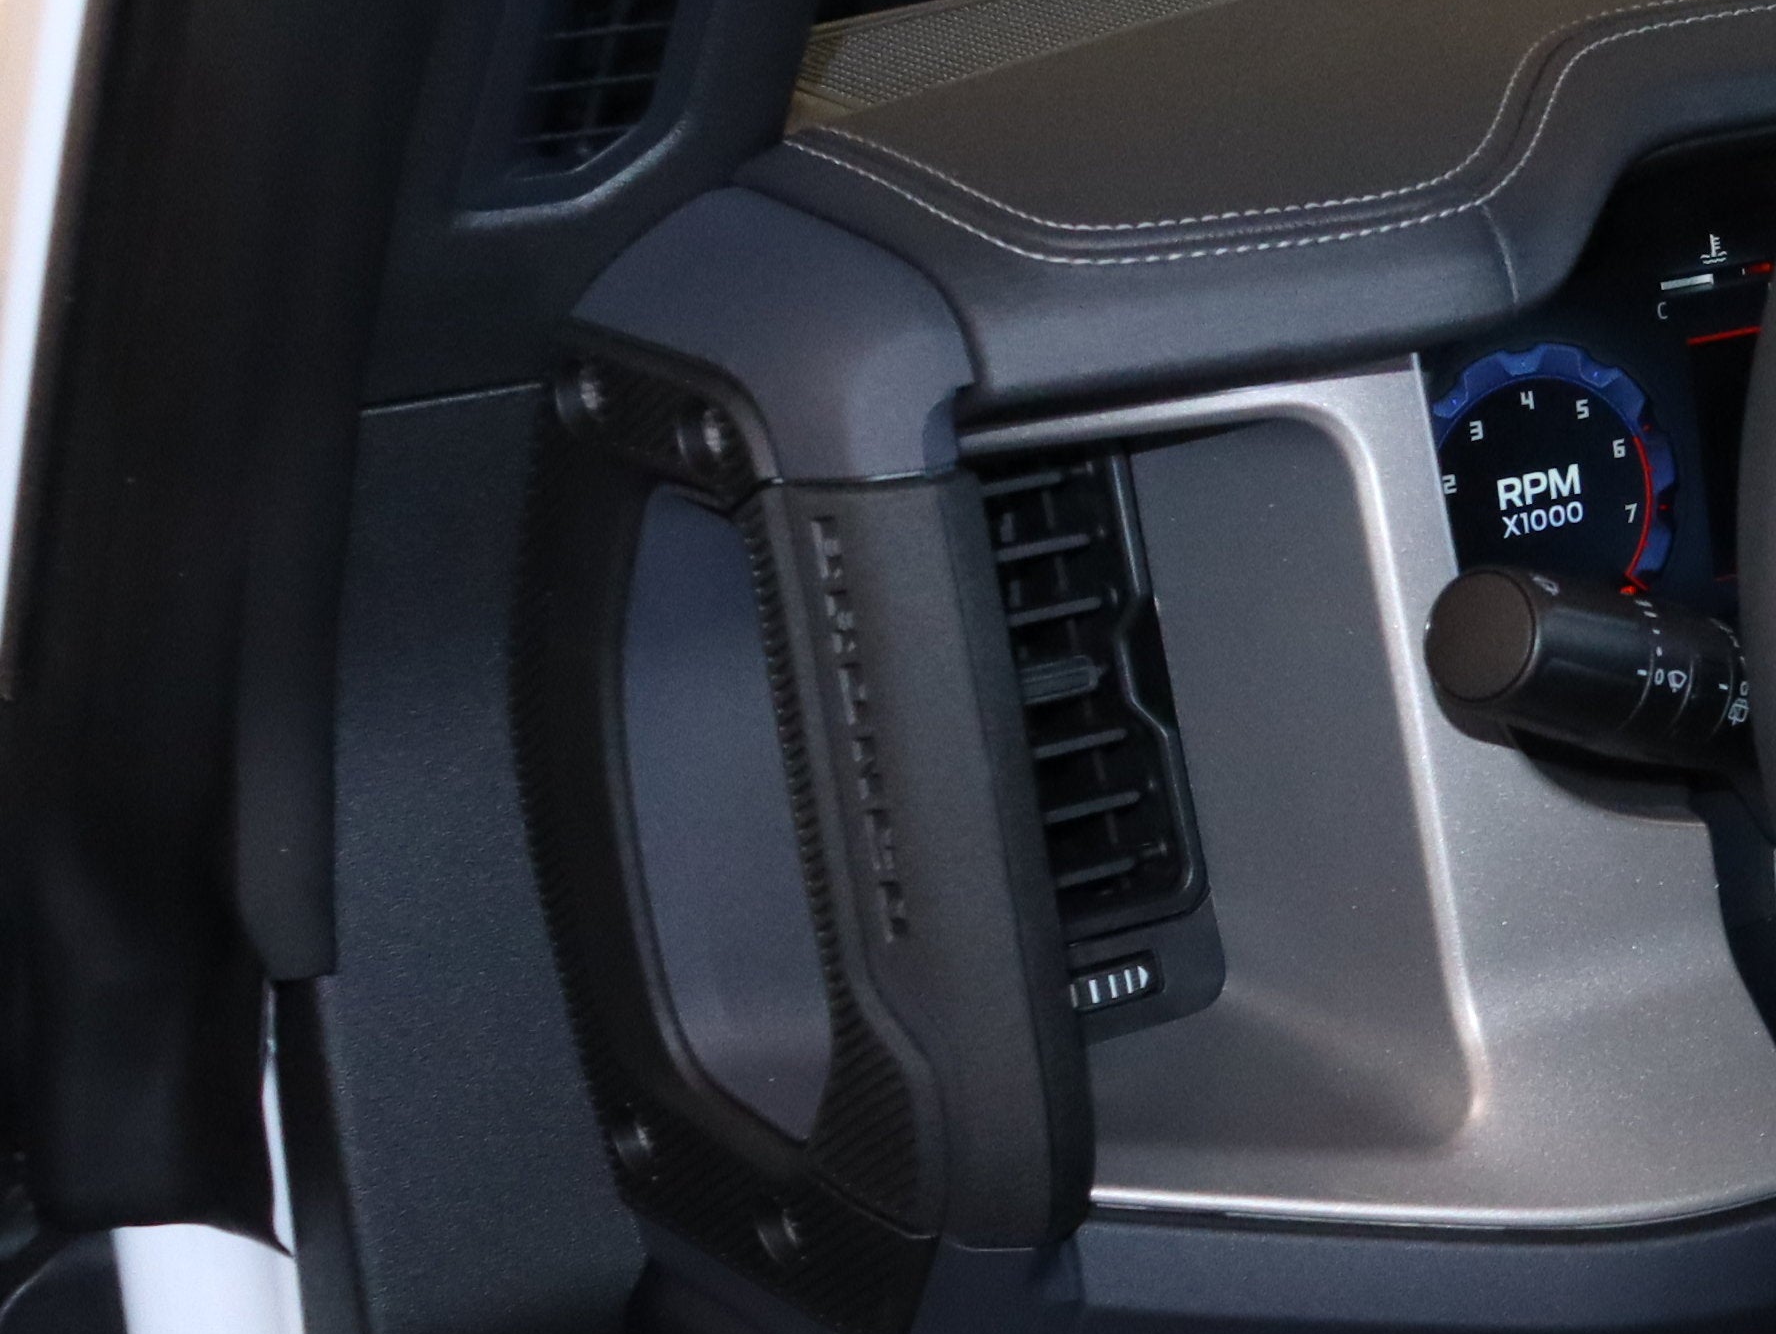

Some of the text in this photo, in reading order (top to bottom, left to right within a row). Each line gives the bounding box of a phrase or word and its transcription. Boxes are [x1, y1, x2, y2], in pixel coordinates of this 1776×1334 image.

[1657, 300, 1669, 320] C
[1520, 390, 1535, 410] 4
[1576, 399, 1590, 419] 5
[1469, 420, 1484, 441] 3
[1612, 438, 1626, 458] 6
[1442, 474, 1457, 495] 2
[1496, 463, 1582, 511] RPM
[1502, 501, 1584, 539] X1000
[1624, 503, 1638, 523] 7
